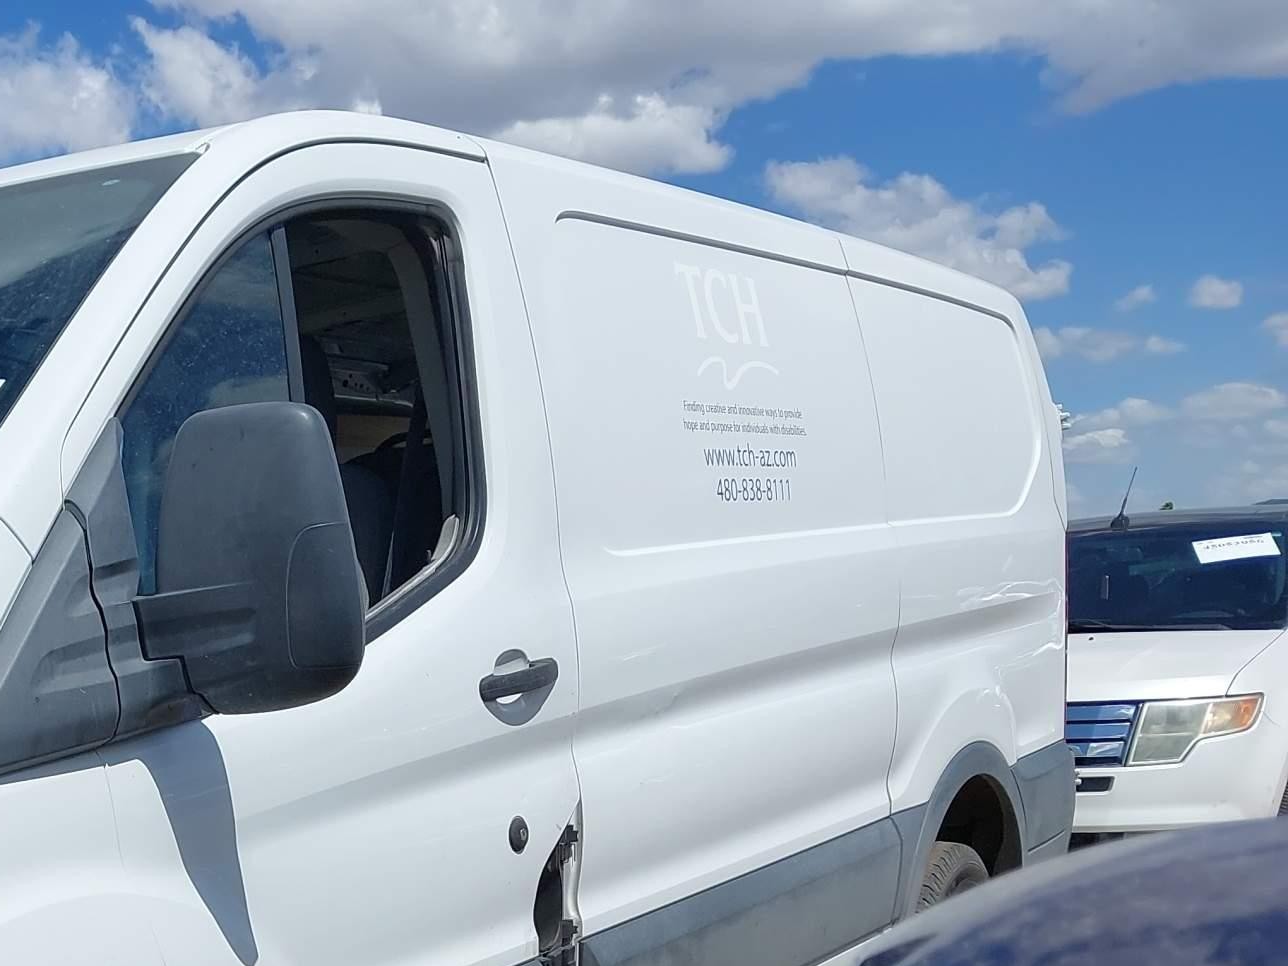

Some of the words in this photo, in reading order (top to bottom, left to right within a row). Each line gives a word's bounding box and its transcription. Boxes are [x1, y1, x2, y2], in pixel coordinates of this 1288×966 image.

[674, 260, 769, 347] TCH
[727, 403, 737, 414] and
[683, 418, 698, 432] hope
[699, 419, 710, 431] and
[711, 422, 733, 434] purpose
[704, 443, 796, 467] www.tch-az.com
[717, 478, 791, 501] 480-838-8111
